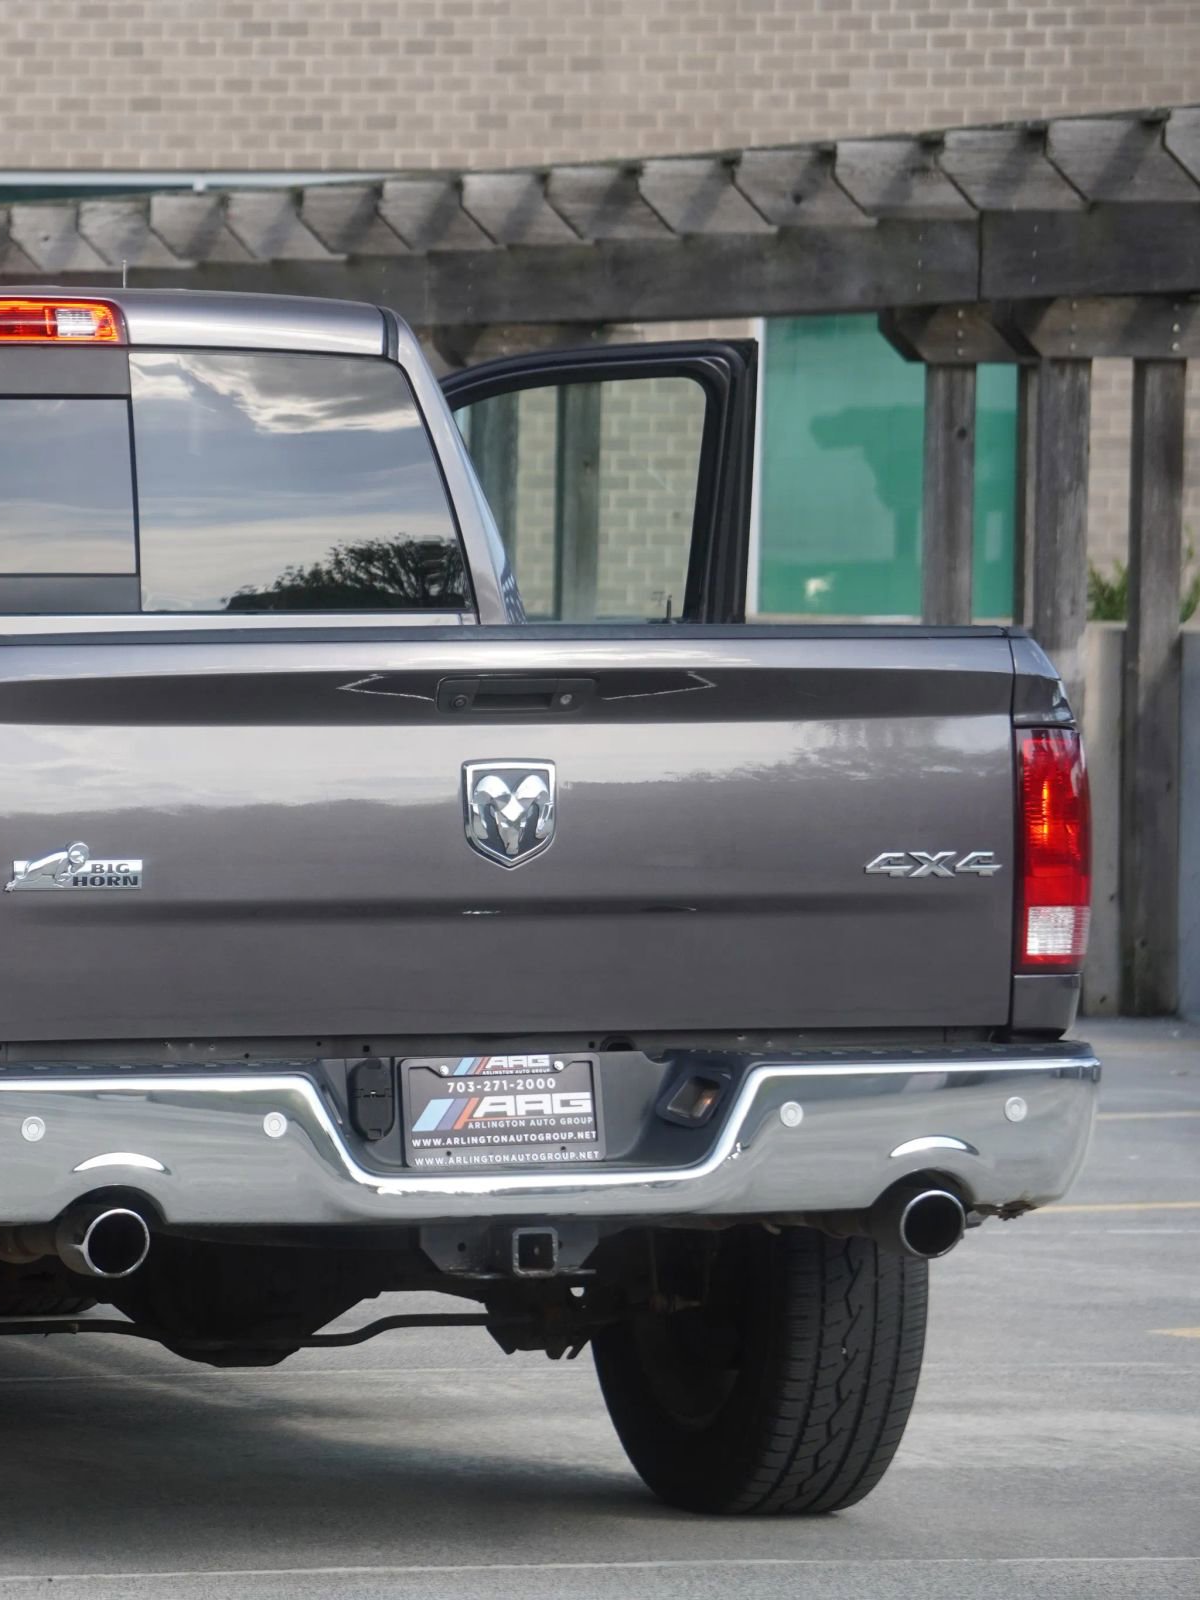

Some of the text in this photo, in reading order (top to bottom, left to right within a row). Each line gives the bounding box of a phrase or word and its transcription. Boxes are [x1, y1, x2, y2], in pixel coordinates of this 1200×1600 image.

[91, 863, 130, 874] BIG
[865, 851, 1003, 877] 4X4
[72, 876, 138, 887] HORN
[485, 1055, 550, 1069] AAG
[447, 1078, 556, 1093] 703-271-2000
[473, 1092, 593, 1118] AAG
[467, 1116, 593, 1129] ARLINGTON AUTO GROUP
[412, 1131, 597, 1147] WWW.ARLINGTONAUTOGROUP.NET
[415, 1151, 600, 1166] WWW.ARLINGTONAUTOGROUP.NET
